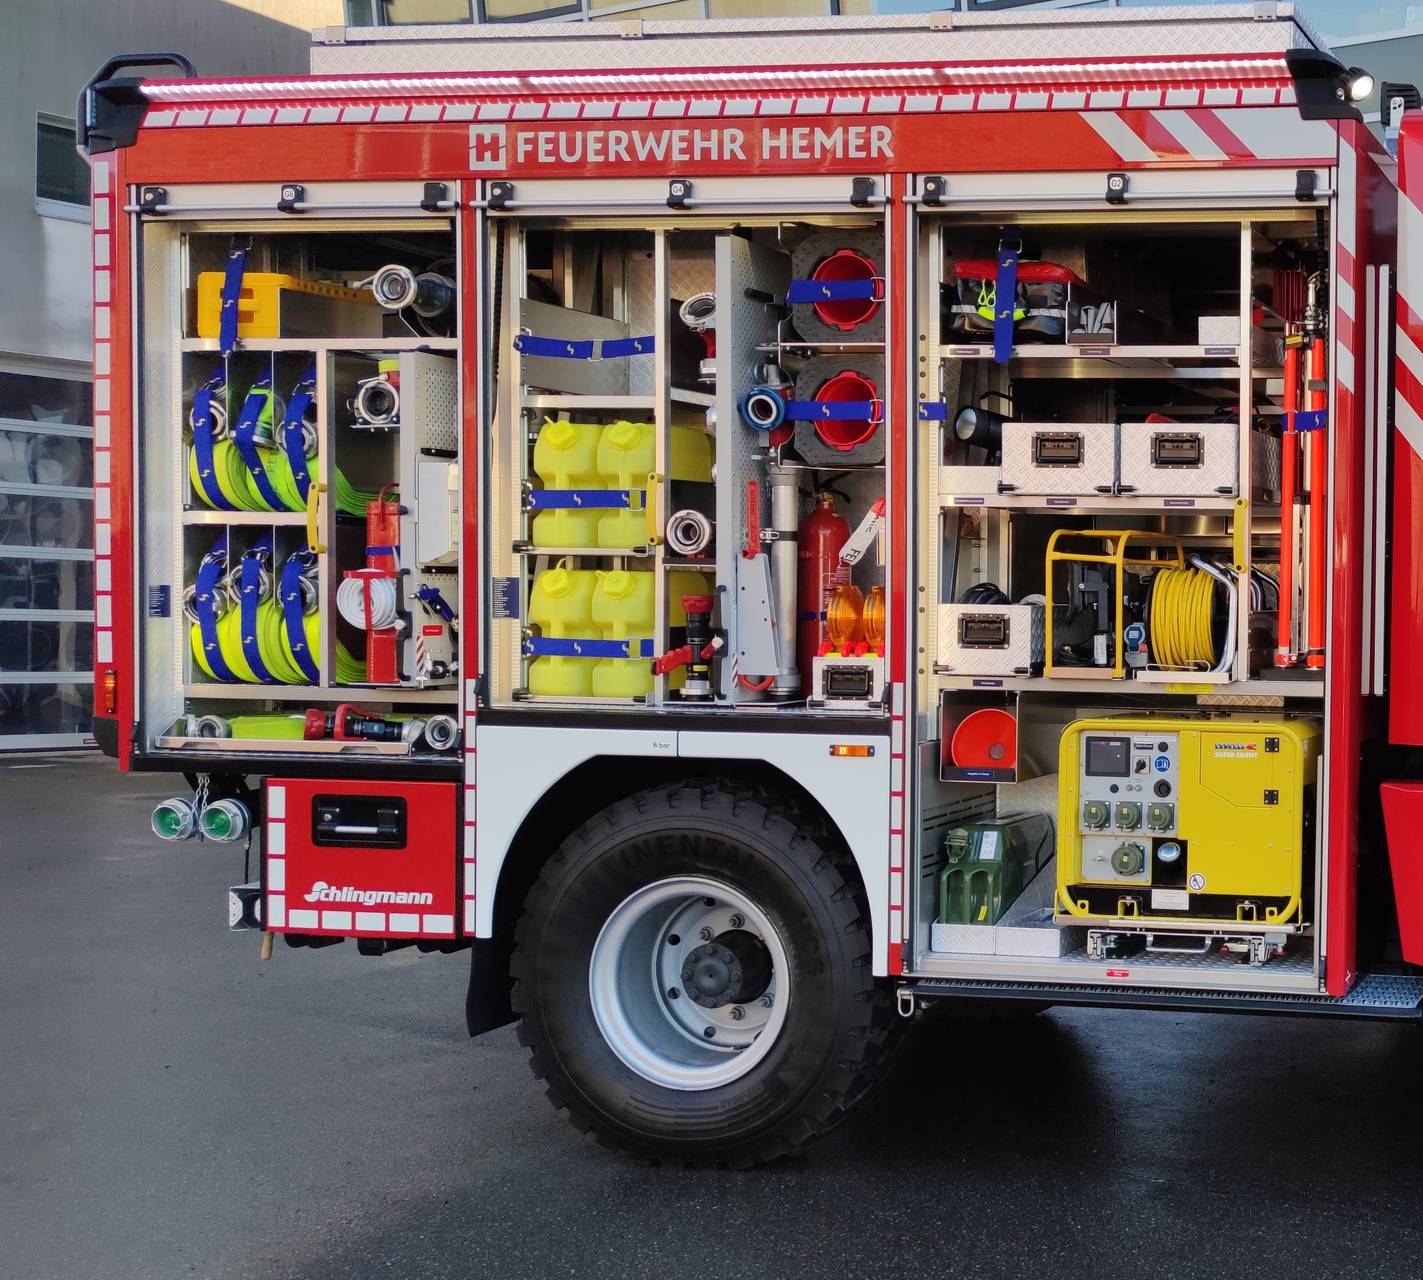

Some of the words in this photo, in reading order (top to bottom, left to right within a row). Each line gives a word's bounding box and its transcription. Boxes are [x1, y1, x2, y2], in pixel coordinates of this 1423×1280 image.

[516, 127, 748, 164] FEUERWEHR
[761, 125, 895, 160] HEMER
[304, 881, 433, 906] Schlingmann
